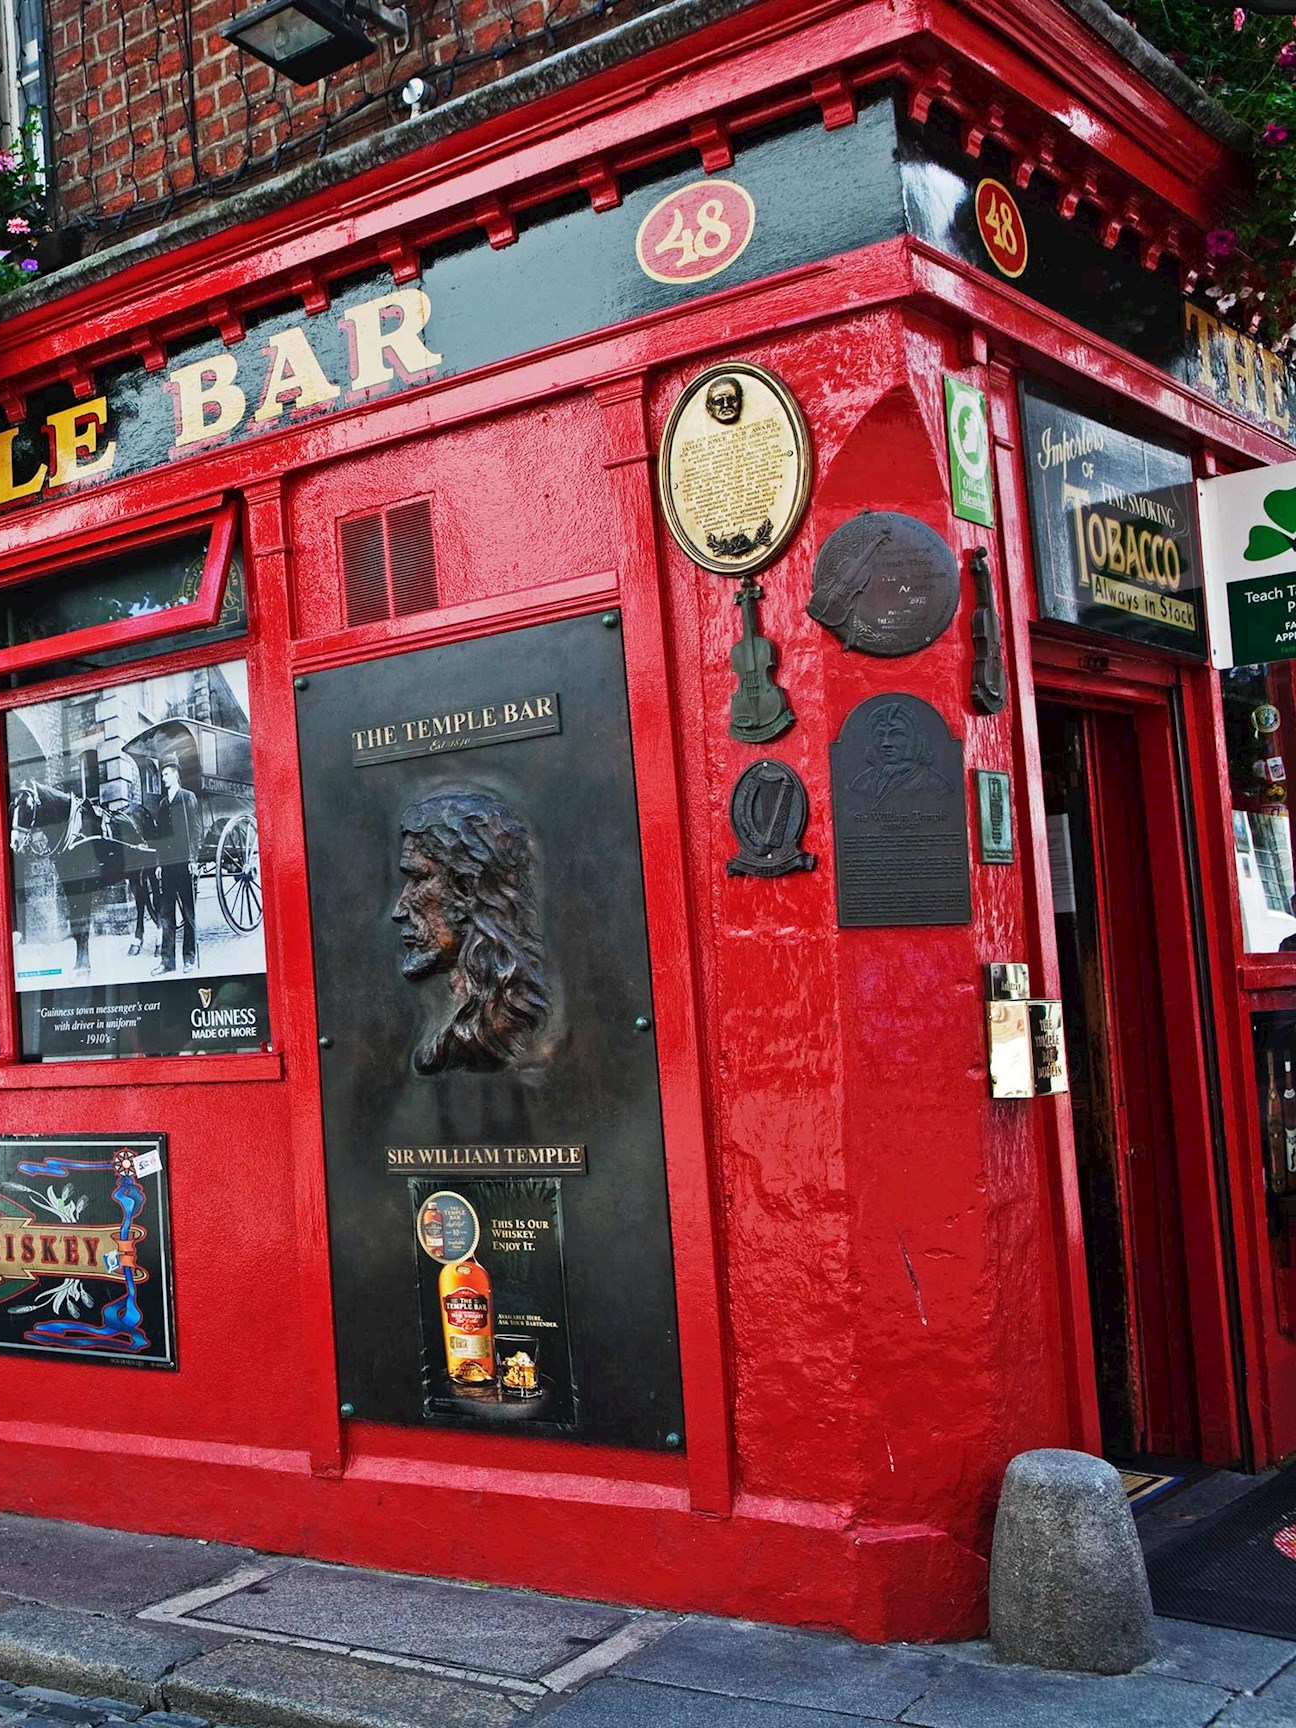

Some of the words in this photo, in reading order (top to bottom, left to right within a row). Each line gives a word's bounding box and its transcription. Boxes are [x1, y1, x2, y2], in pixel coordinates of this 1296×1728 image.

[655, 198, 732, 268] 48
[985, 192, 1017, 255] 48
[168, 288, 443, 447] BAR
[1185, 301, 1289, 433] THE
[707, 436, 727, 446] JOYCE
[732, 430, 747, 439] PUB
[751, 422, 777, 433] AWARD
[1038, 426, 1104, 479] Importers
[1081, 461, 1095, 479] OF
[1100, 481, 1127, 512] FINE
[1129, 493, 1176, 529] SMOKING
[1062, 481, 1181, 592] TOBACCO
[1094, 575, 1140, 610] Always
[1144, 593, 1156, 613] in
[1160, 594, 1194, 628] Stock
[1244, 586, 1283, 604] Teach
[352, 725, 398, 750] THE
[402, 707, 497, 742] TEMPLE
[504, 697, 554, 725] BAR
[429, 740, 447, 752] Est.
[75, 1006, 95, 1015] town
[143, 1001, 161, 1011] cart
[191, 1008, 256, 1028] GUINNESS
[53, 1021, 71, 1032] with
[71, 1020, 96, 1031] driver
[96, 1020, 105, 1030] in
[191, 1029, 217, 1039] MADE
[217, 1028, 230, 1038] OF
[230, 1026, 257, 1038] MORE
[387, 1149, 416, 1165] SIR
[418, 1148, 500, 1165] WILLIAM
[505, 1147, 582, 1164] TEMPLE
[490, 1219, 513, 1229] THIS
[515, 1219, 526, 1228] IS
[527, 1219, 550, 1229] OUR
[491, 1230, 537, 1239] WHISKEY.
[492, 1240, 521, 1252] ENJOY
[522, 1241, 536, 1251] IT.
